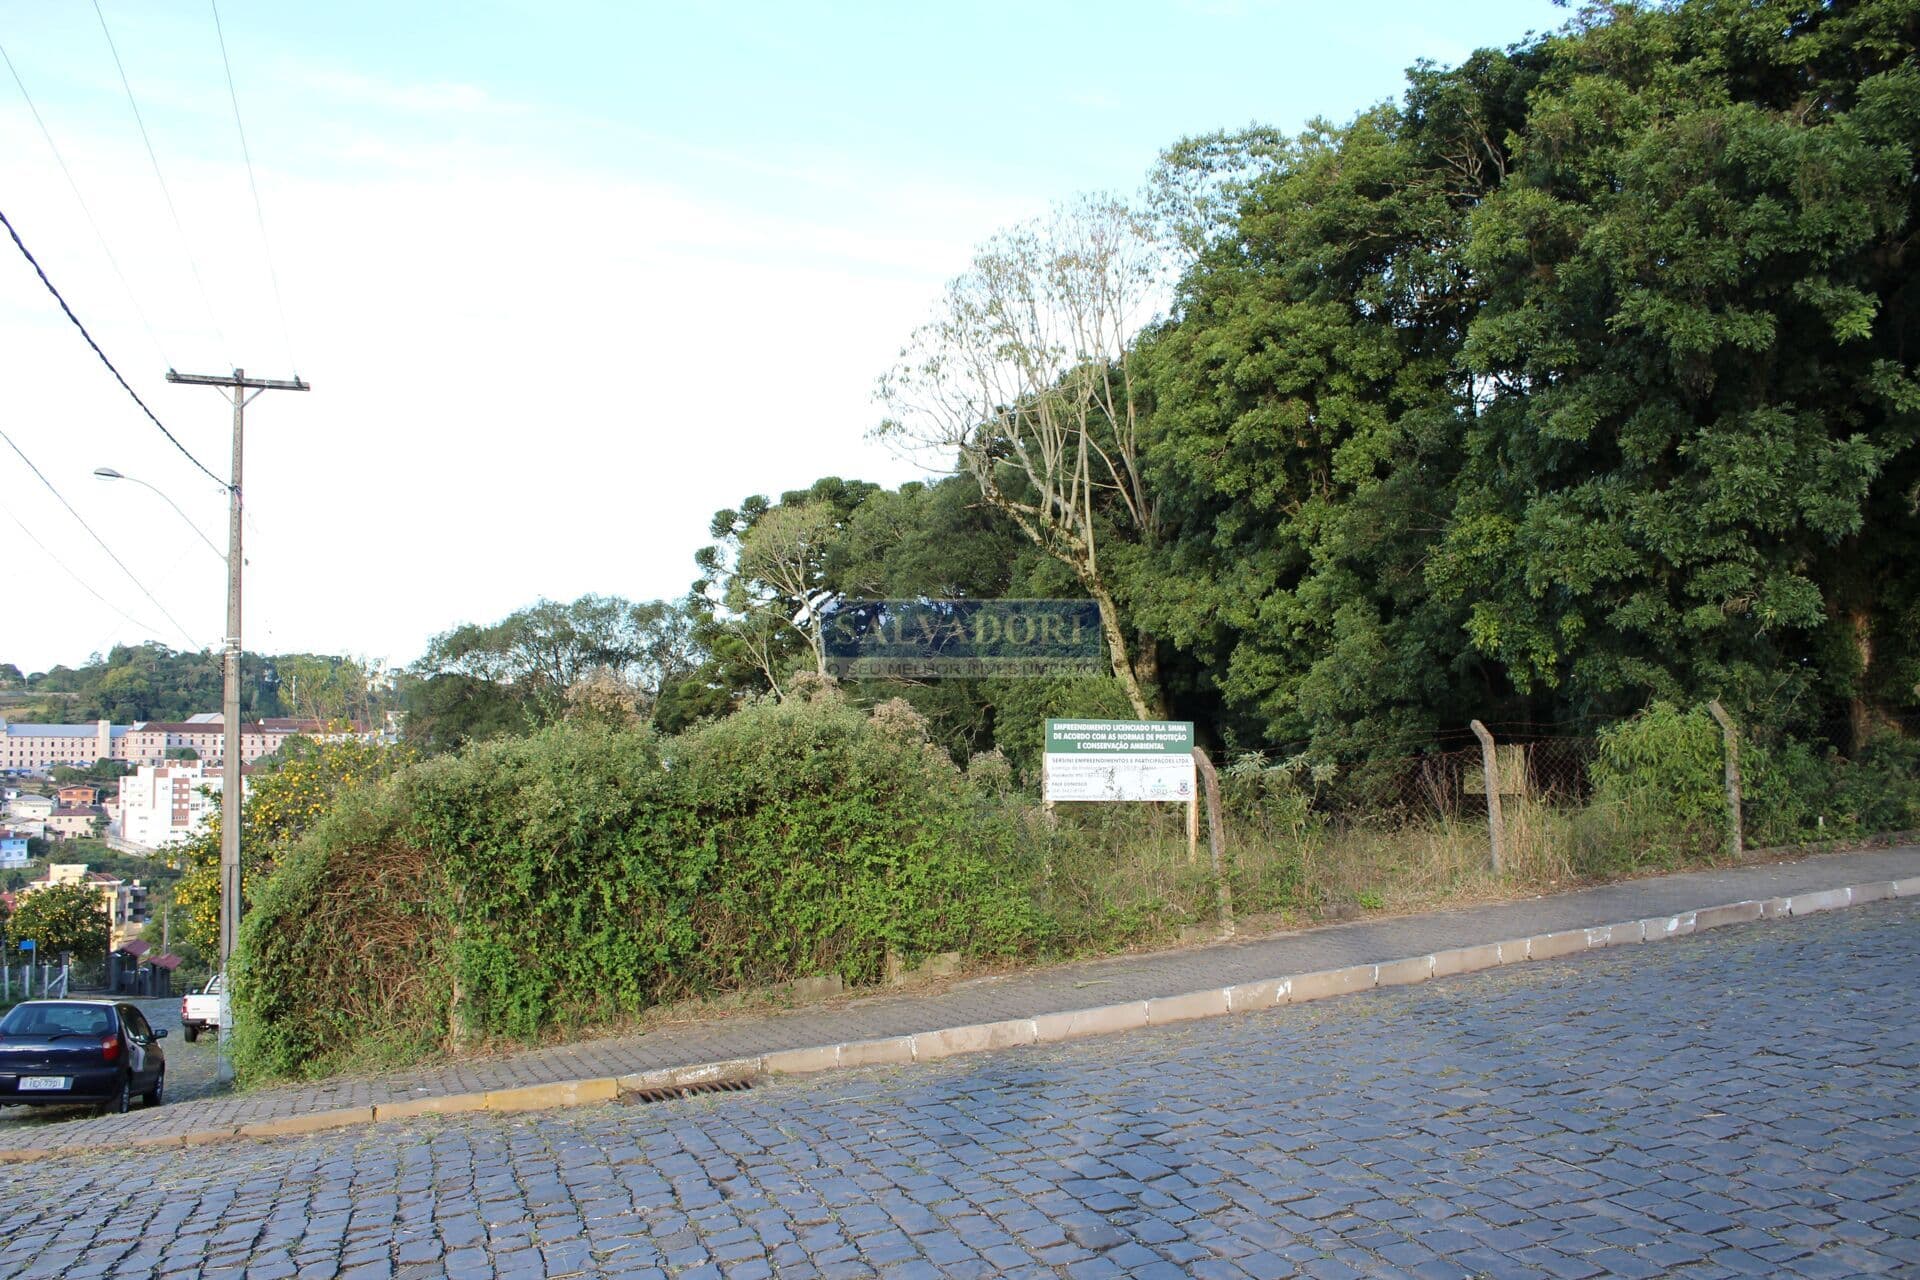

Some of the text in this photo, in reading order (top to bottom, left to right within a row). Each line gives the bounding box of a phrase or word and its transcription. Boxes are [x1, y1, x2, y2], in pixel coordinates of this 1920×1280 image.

[1112, 724, 1150, 732] LICENCIADO
[1151, 724, 1166, 732] PELA
[1053, 732, 1062, 740] DE
[1063, 732, 1090, 740] ACORDO
[1091, 732, 1107, 740] COM
[1117, 733, 1144, 741] NORMAS
[1146, 733, 1154, 741] DE
[1155, 733, 1187, 742] PROTEÇÃO
[1129, 742, 1165, 750] AMBIENTAL
